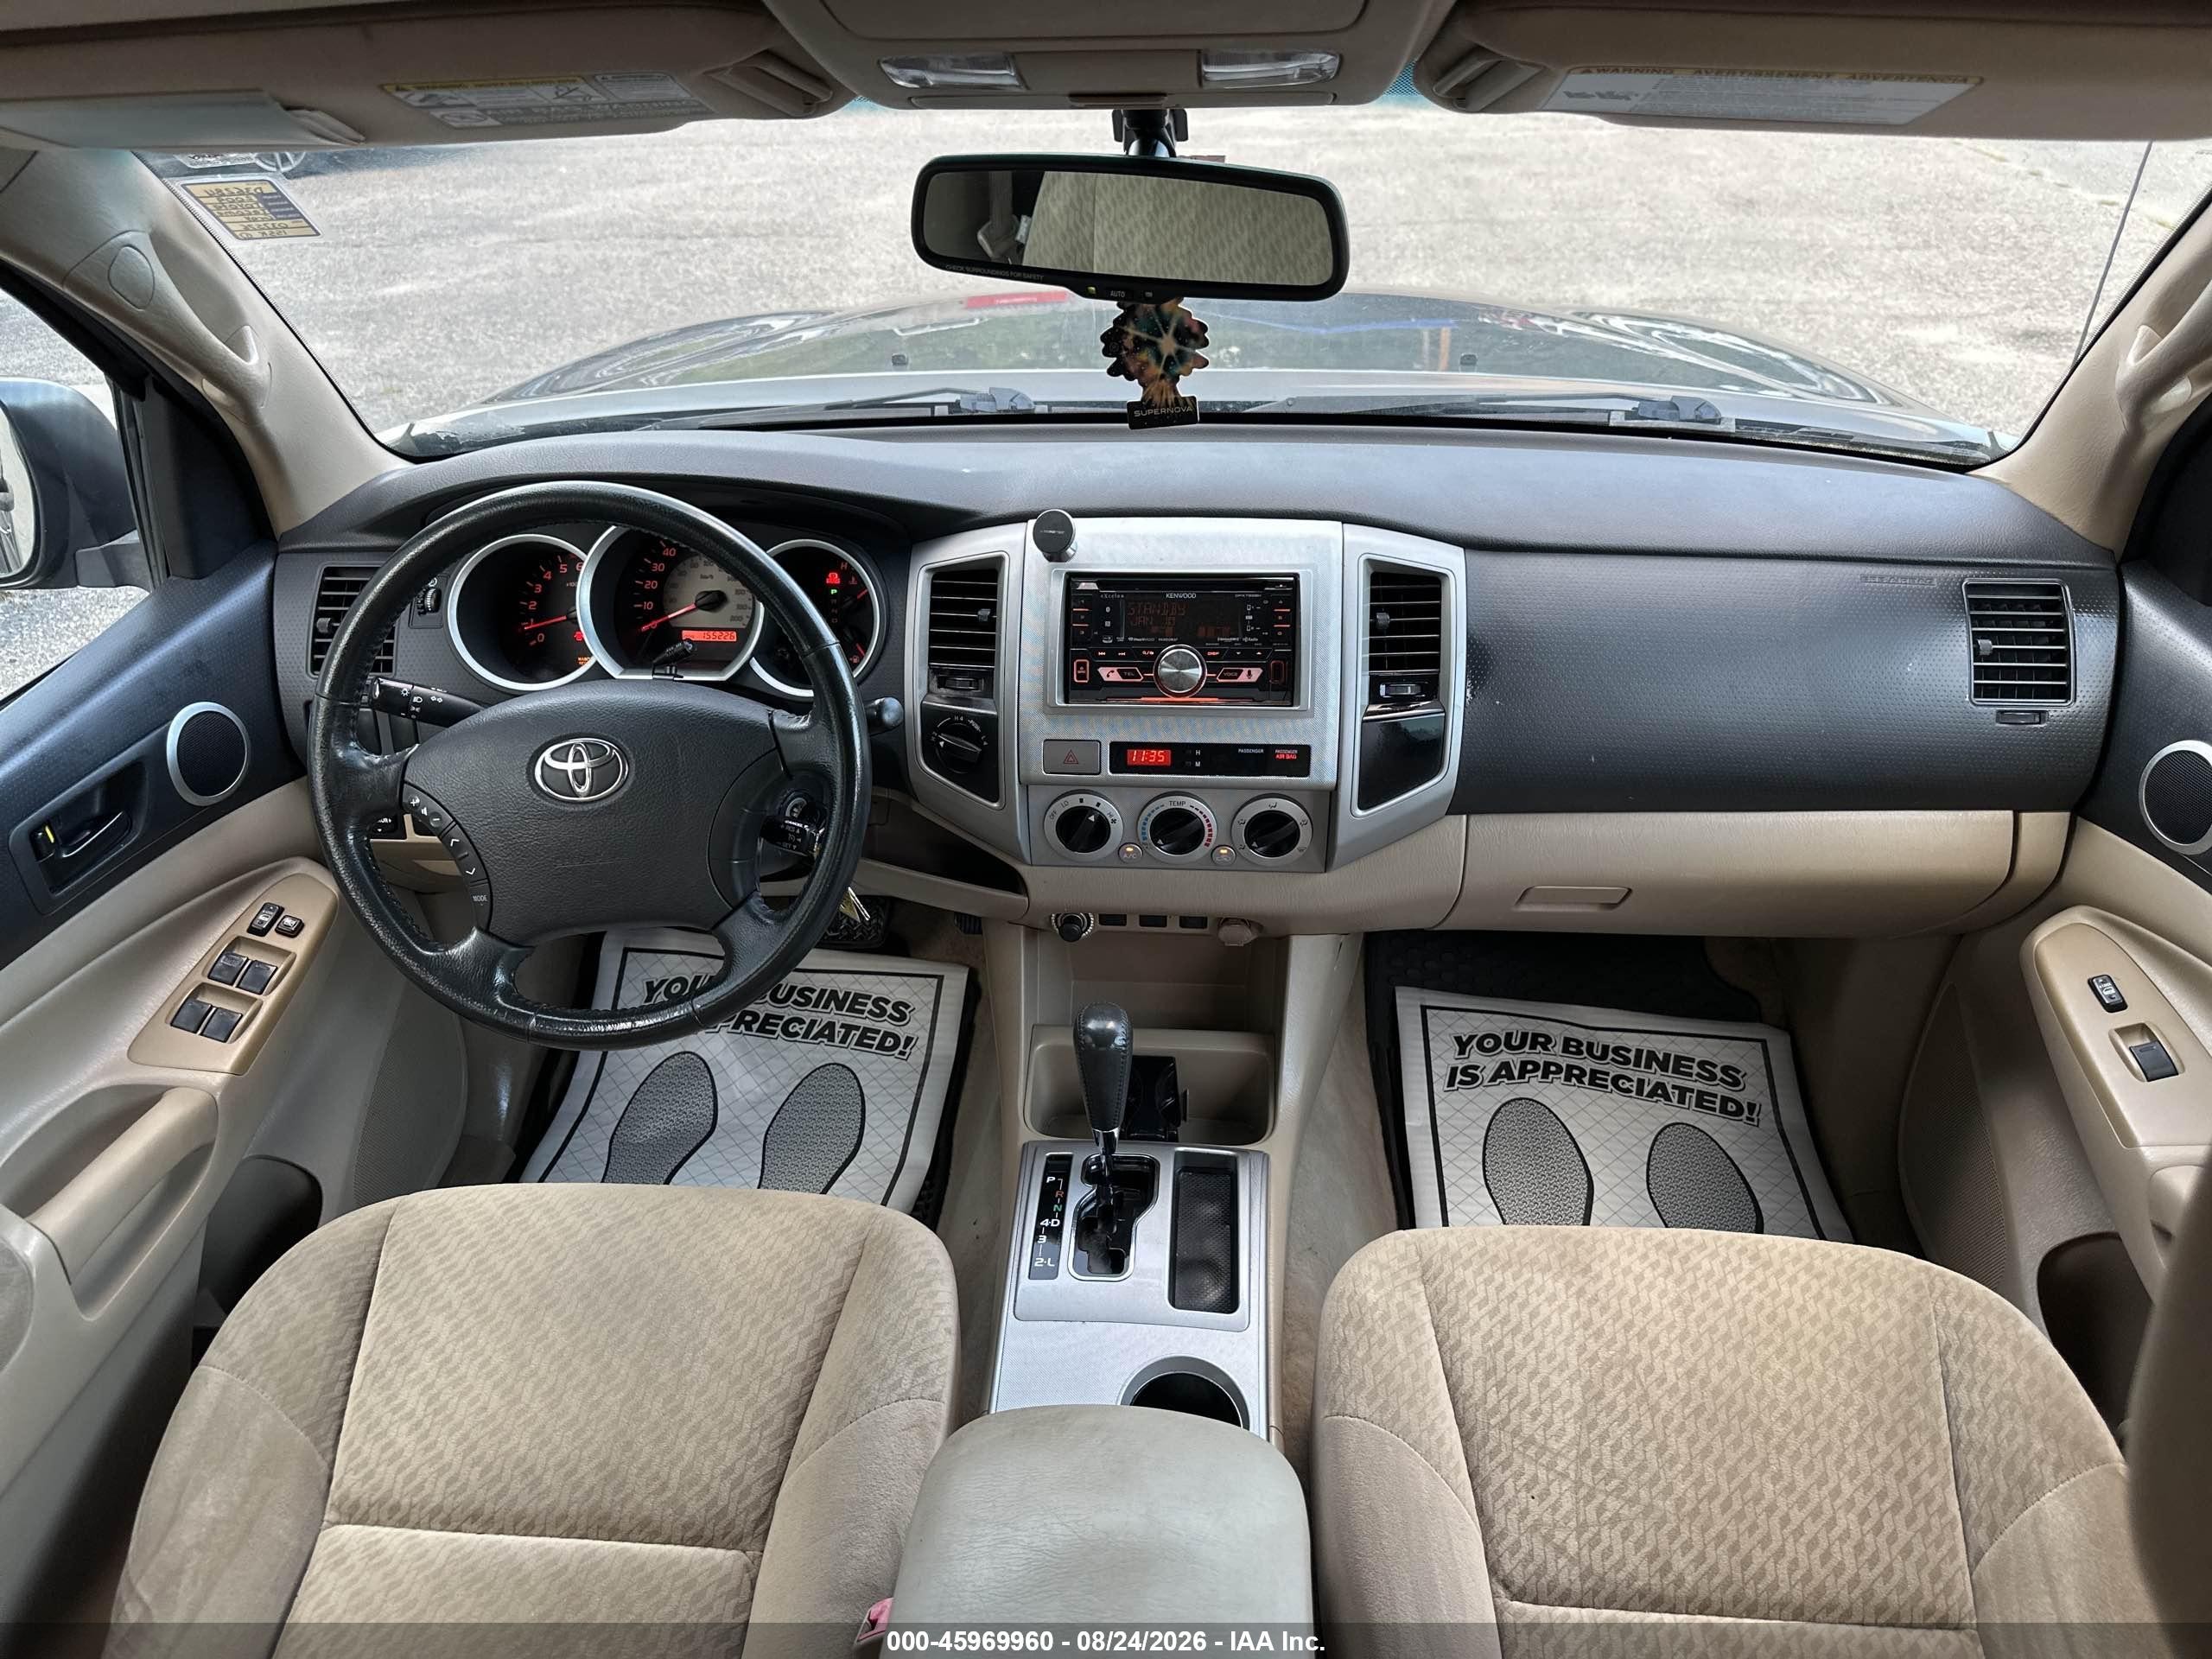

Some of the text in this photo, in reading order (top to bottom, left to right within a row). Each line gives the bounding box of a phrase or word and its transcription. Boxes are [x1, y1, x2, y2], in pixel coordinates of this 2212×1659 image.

[1595, 67, 1674, 75] WARNING
[965, 266, 1009, 276] SURROUNDINGS
[1022, 271, 1044, 282] SAFETY
[1109, 289, 1126, 298] AUTO
[1134, 406, 1193, 417] SUPERNOVA
[663, 547, 677, 556] 40
[559, 563, 568, 573] 5
[652, 563, 665, 572] 30
[543, 571, 552, 580] 4
[534, 583, 543, 594] 3
[644, 581, 658, 589] 20
[529, 601, 537, 610] 2
[642, 601, 654, 610] 10
[537, 632, 545, 643] 0
[702, 632, 735, 640] 155226
[1132, 749, 1165, 763] 11:35
[1060, 799, 1070, 810] LO
[1048, 810, 1059, 821] OFF
[750, 982, 916, 1027] USINESS
[1452, 1030, 1748, 1092] YOUR BUSINESS
[1443, 1058, 1762, 1128] IS APPRECIATED!
[1055, 1190, 1065, 1198] R
[1053, 1204, 1063, 1212] N
[1037, 1235, 1047, 1243] 3
